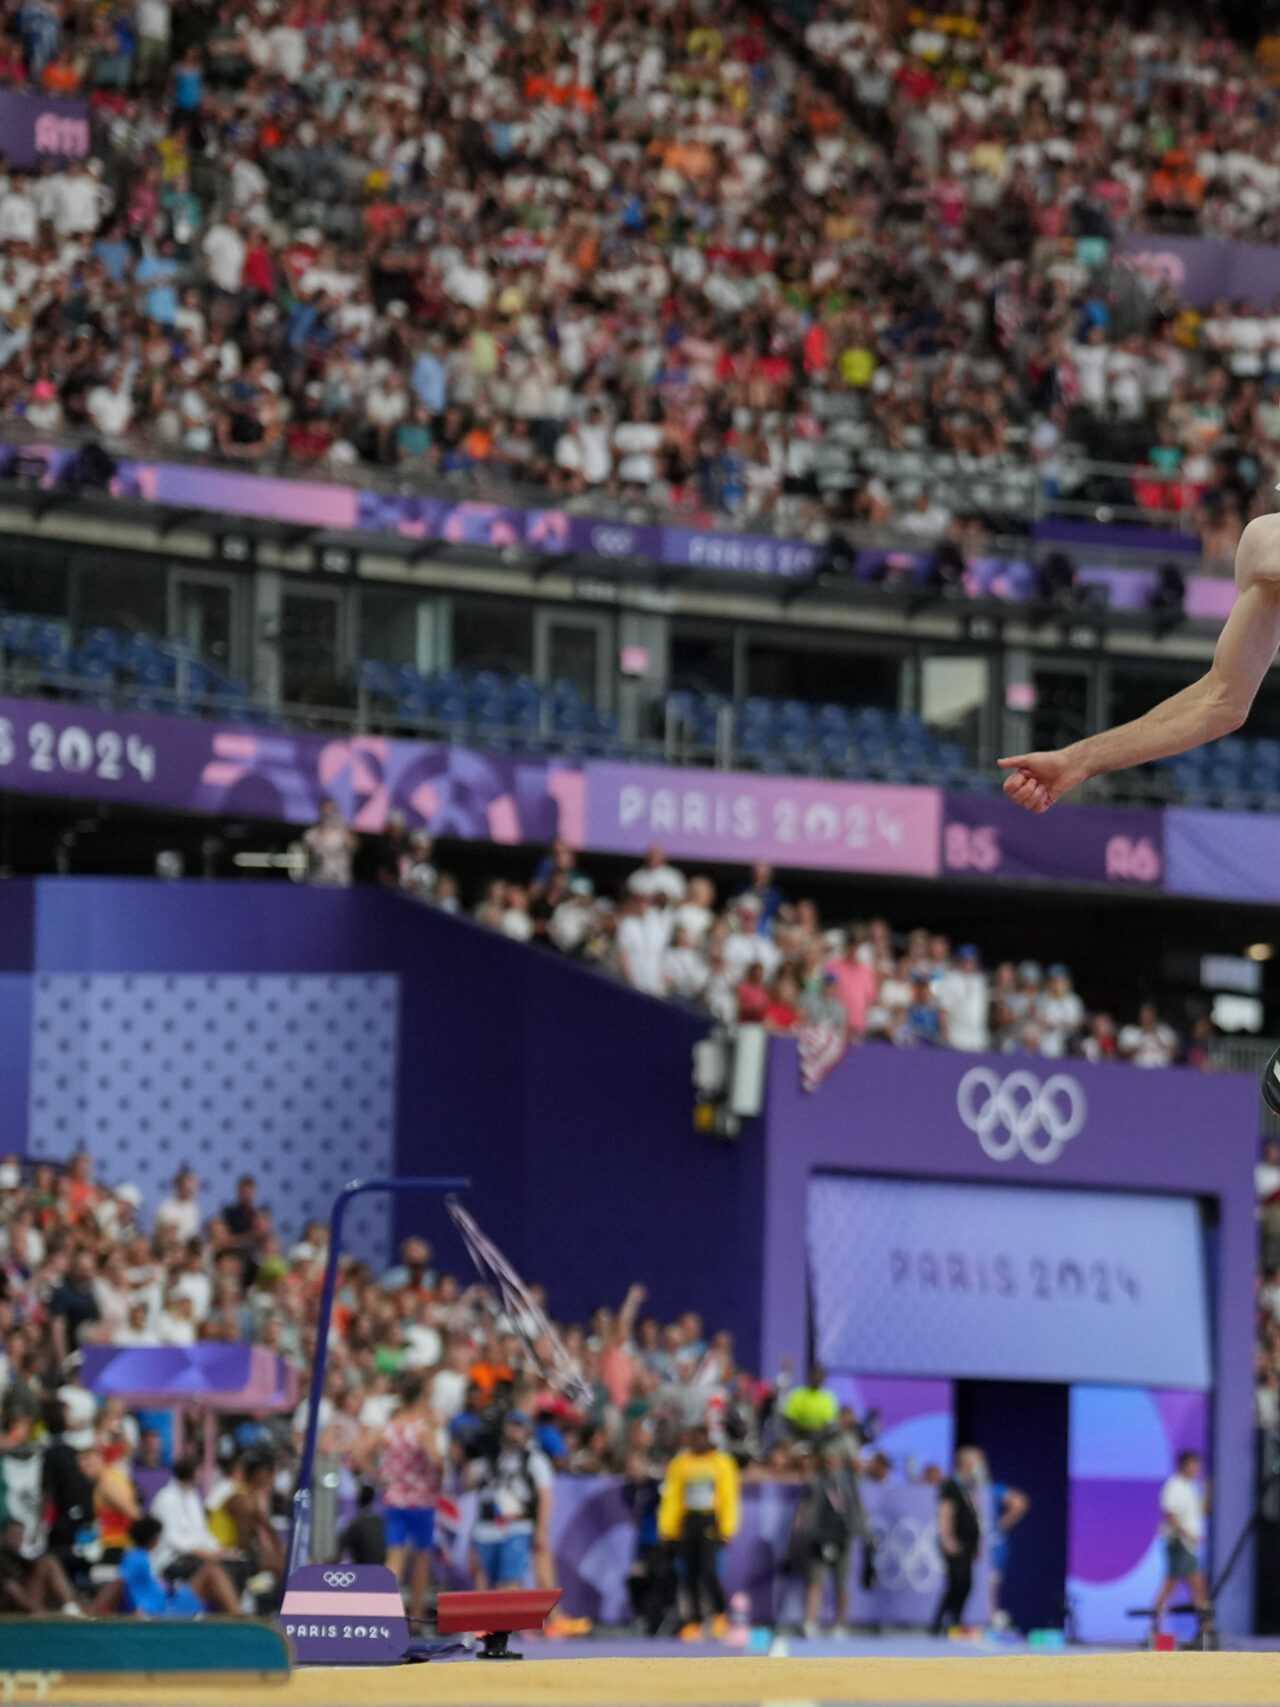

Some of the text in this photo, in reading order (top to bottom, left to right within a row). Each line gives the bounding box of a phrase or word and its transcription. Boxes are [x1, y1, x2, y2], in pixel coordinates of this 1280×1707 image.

[28, 721, 156, 783] 2024
[619, 785, 905, 847] PARIS 2024
[888, 1249, 1142, 1305] PARIS 2024
[286, 1624, 391, 1639] PARIS 2024
